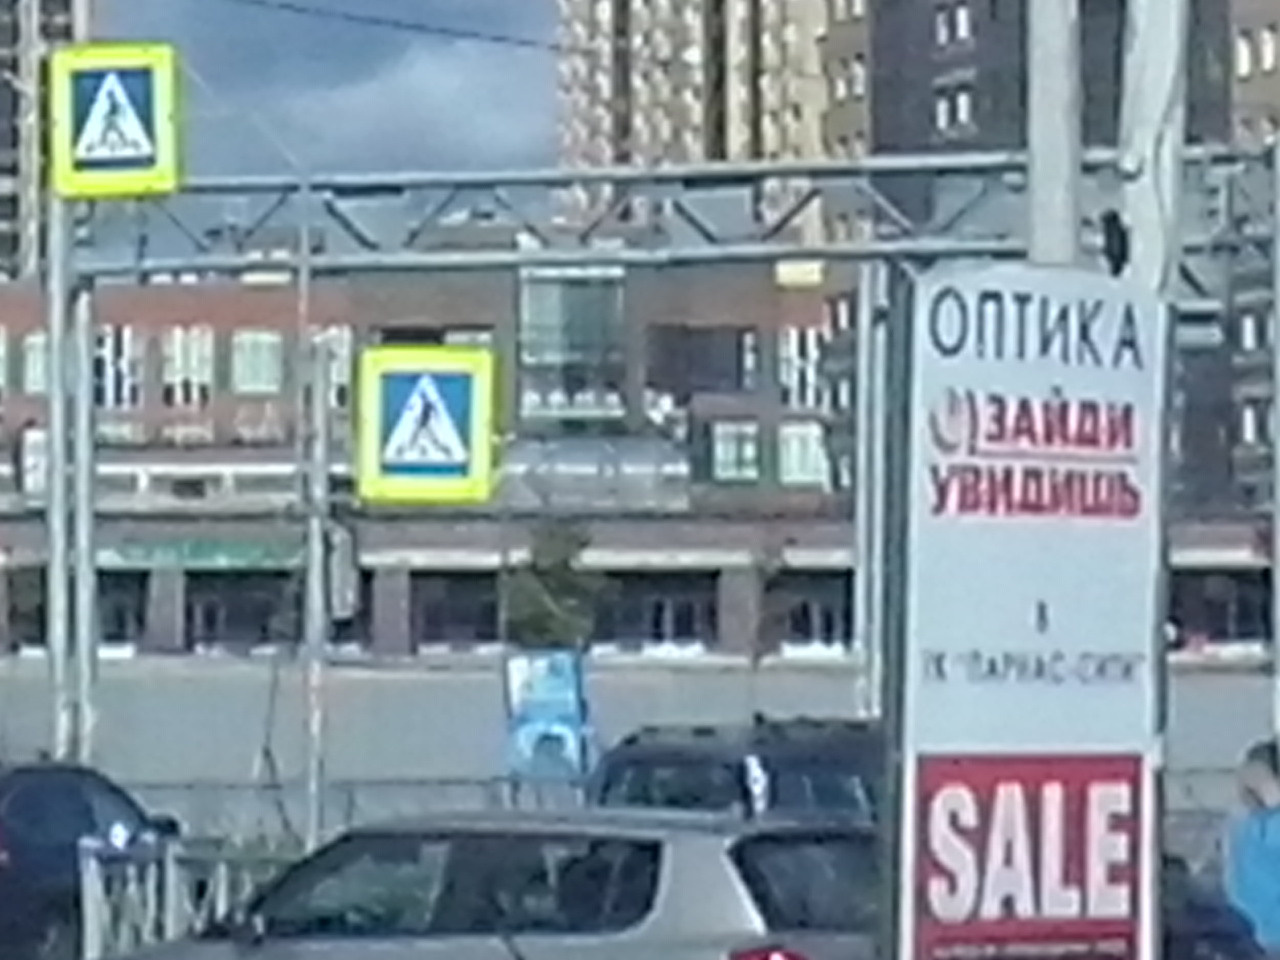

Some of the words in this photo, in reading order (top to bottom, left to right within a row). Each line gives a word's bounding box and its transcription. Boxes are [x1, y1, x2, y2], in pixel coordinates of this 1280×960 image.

[929, 286, 1144, 370] ОПТИКА
[984, 386, 1134, 450] ЗАЙДИ
[931, 464, 1141, 518] УВИДИШЬ
[927, 781, 1133, 924] SALE
